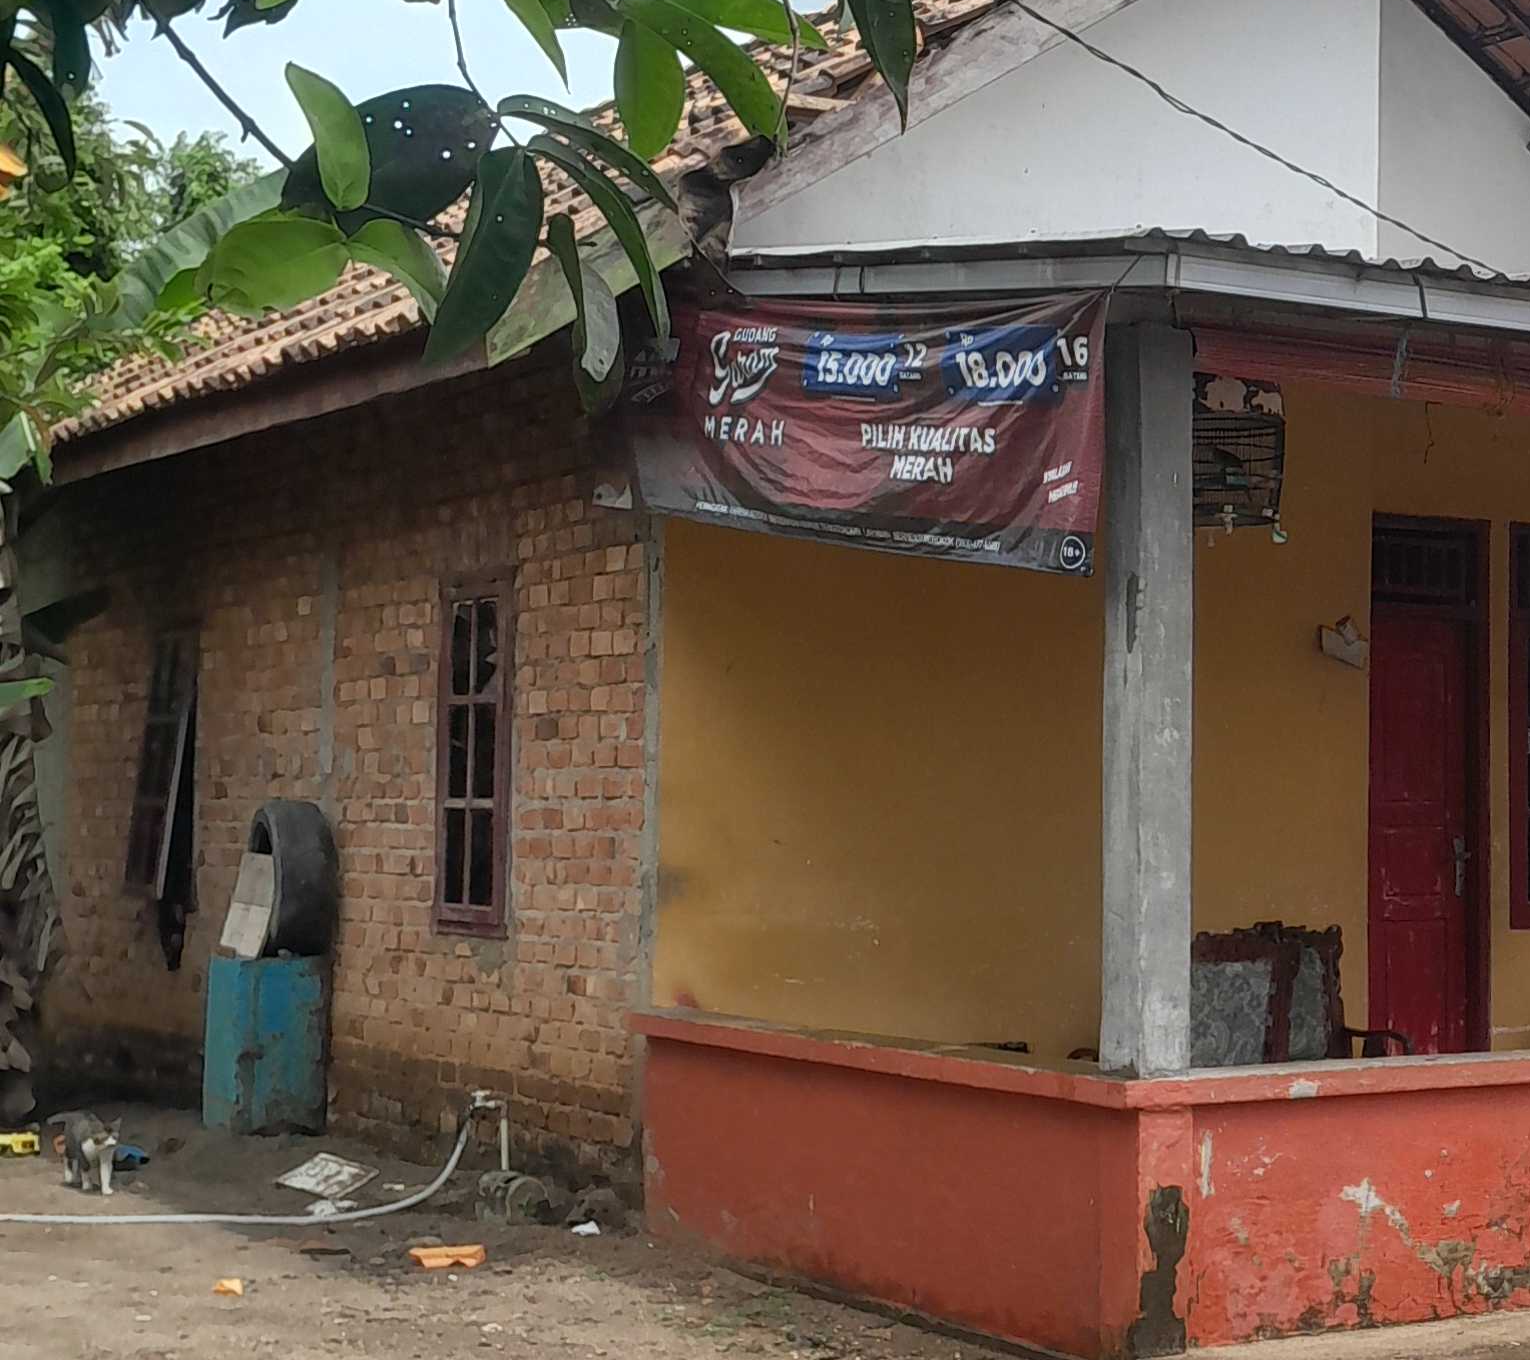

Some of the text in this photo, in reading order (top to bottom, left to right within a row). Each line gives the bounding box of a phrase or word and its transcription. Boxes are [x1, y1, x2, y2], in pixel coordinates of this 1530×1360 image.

[733, 327, 778, 343] GUDANG
[817, 342, 927, 387] 15.000 12
[955, 336, 1089, 388] 18.000 16
[703, 415, 786, 446] MERAH
[861, 423, 997, 454] PILIH KUALITAS
[889, 455, 954, 485] MERAH
